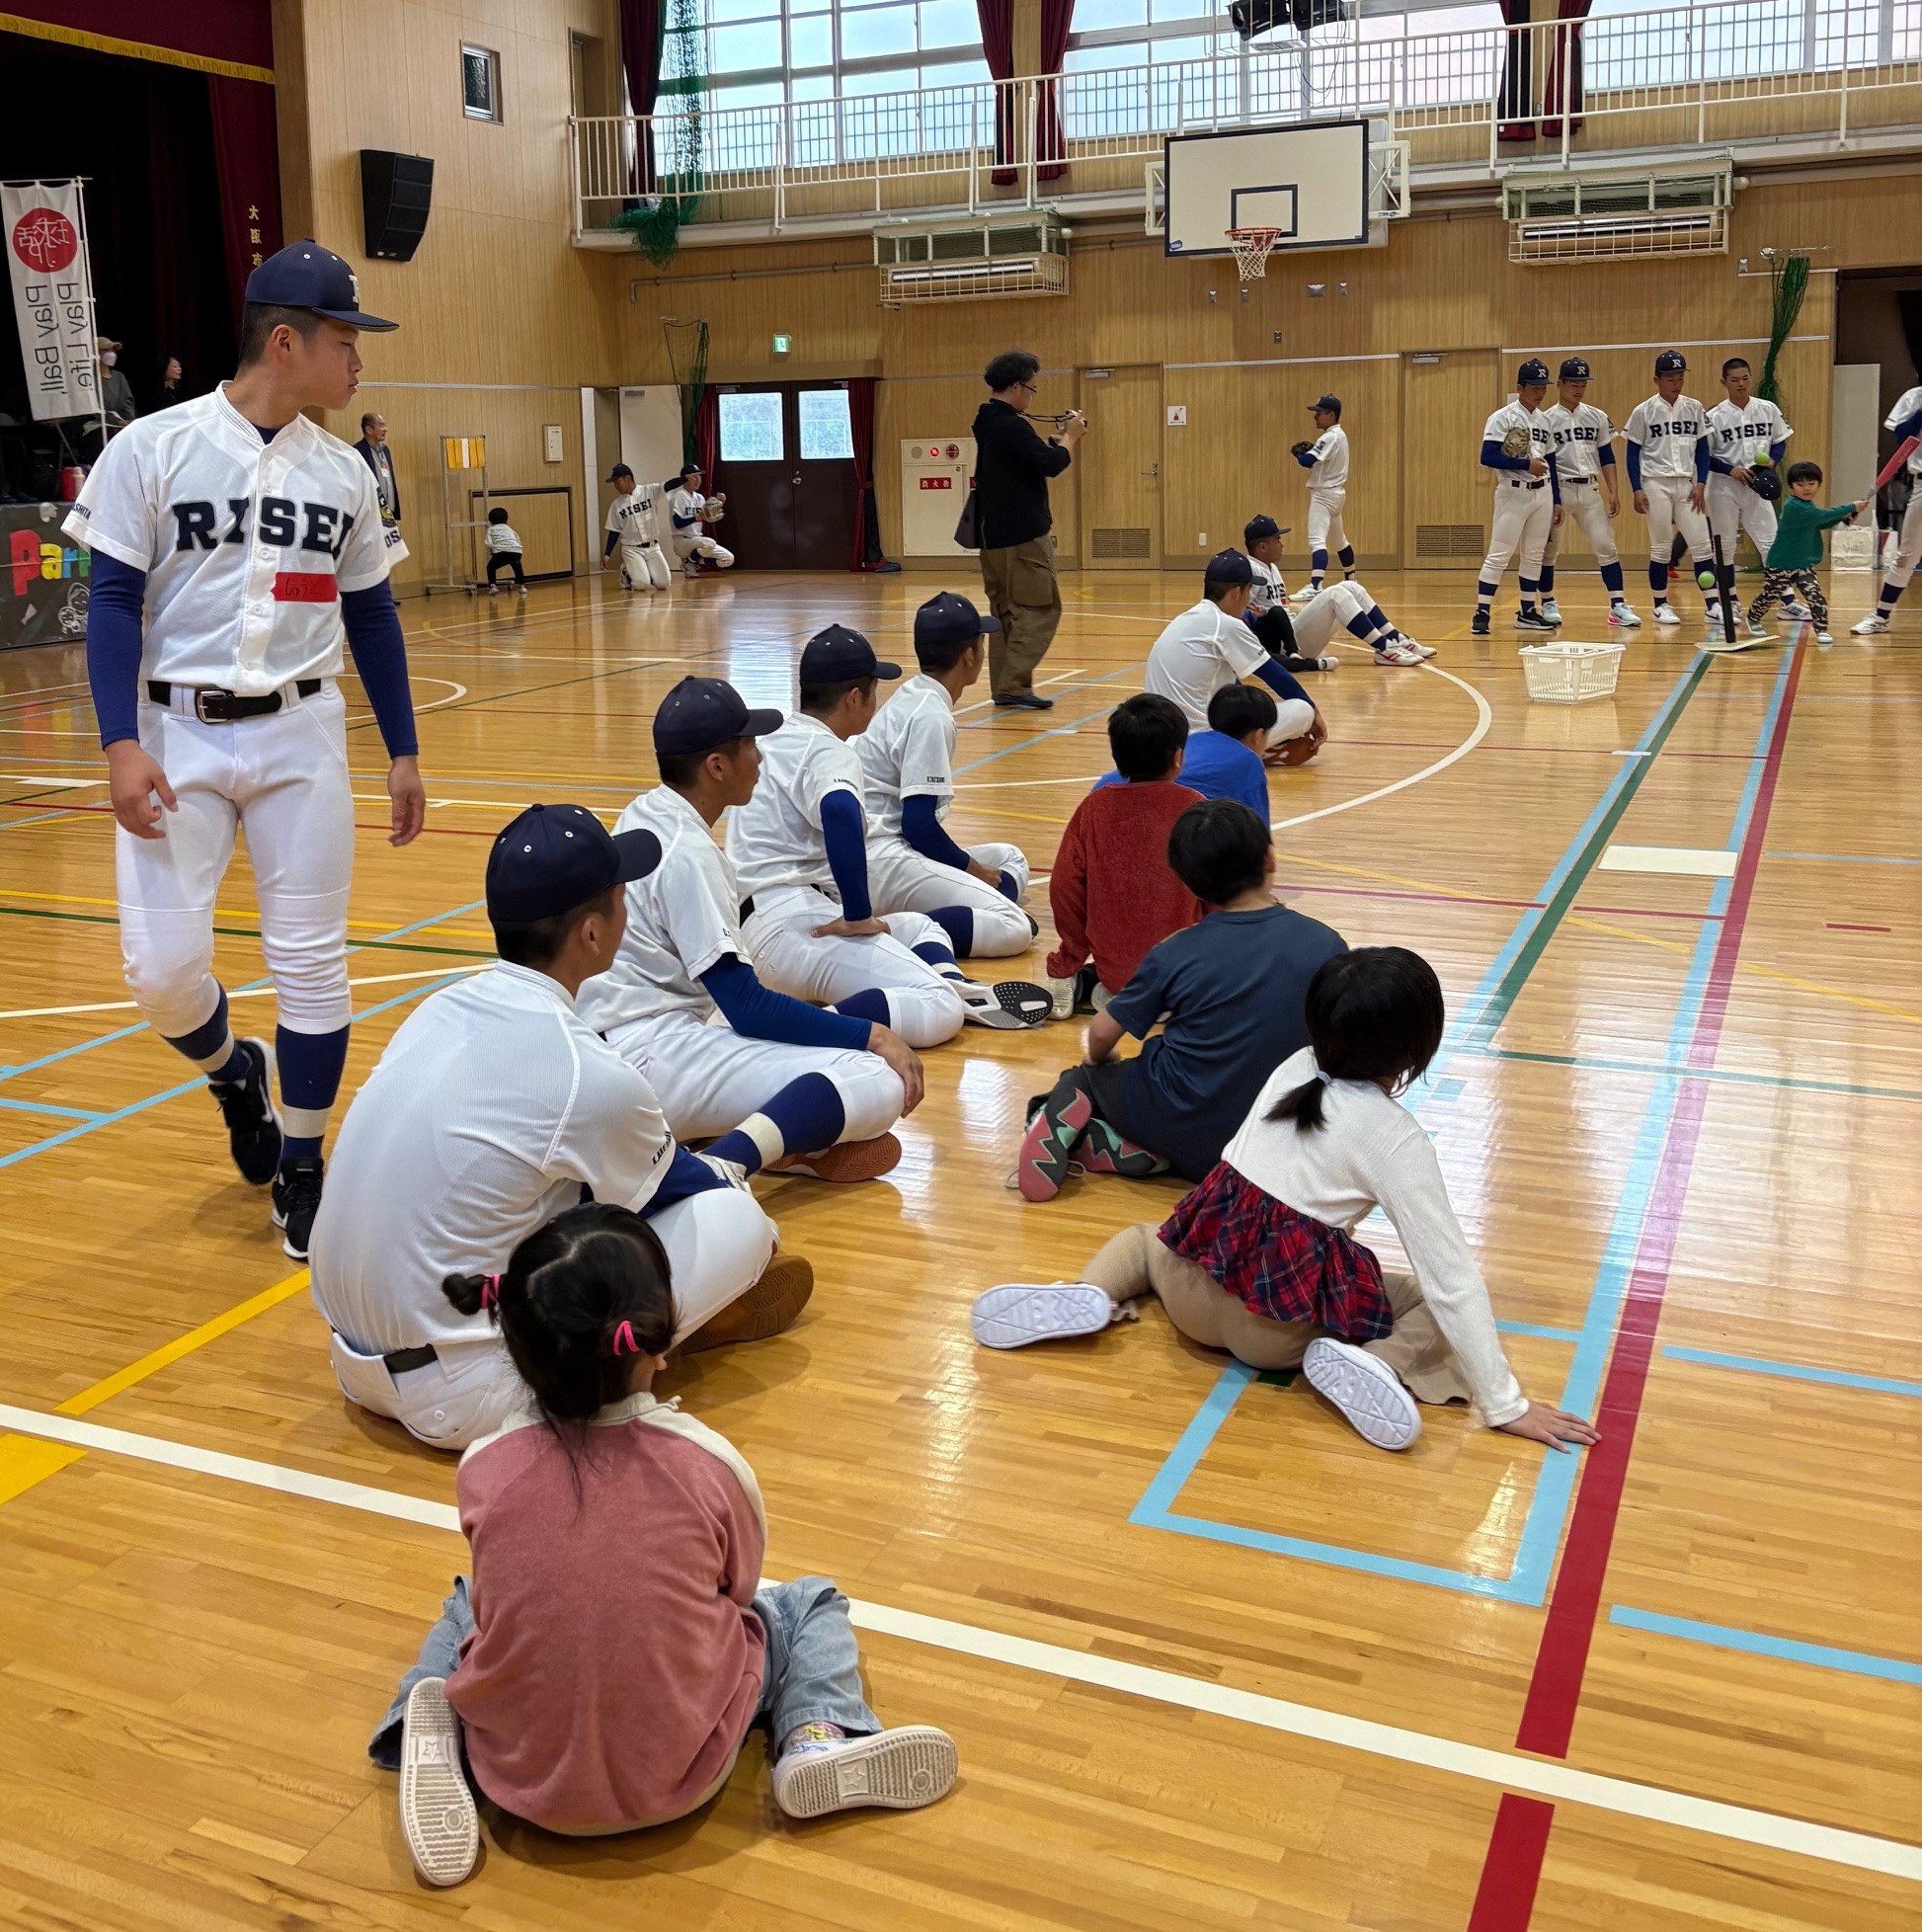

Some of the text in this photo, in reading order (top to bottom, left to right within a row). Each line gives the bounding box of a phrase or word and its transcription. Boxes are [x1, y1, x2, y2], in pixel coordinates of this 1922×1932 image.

[1575, 365, 1586, 374] R
[1671, 359, 1682, 368] R
[1537, 368, 1547, 378] R
[1648, 420, 1698, 439] RISEI
[1721, 422, 1774, 443] RISEI
[72, 503, 92, 521] SHITA
[618, 498, 653, 520] RISEI
[172, 496, 356, 561] RISEI
